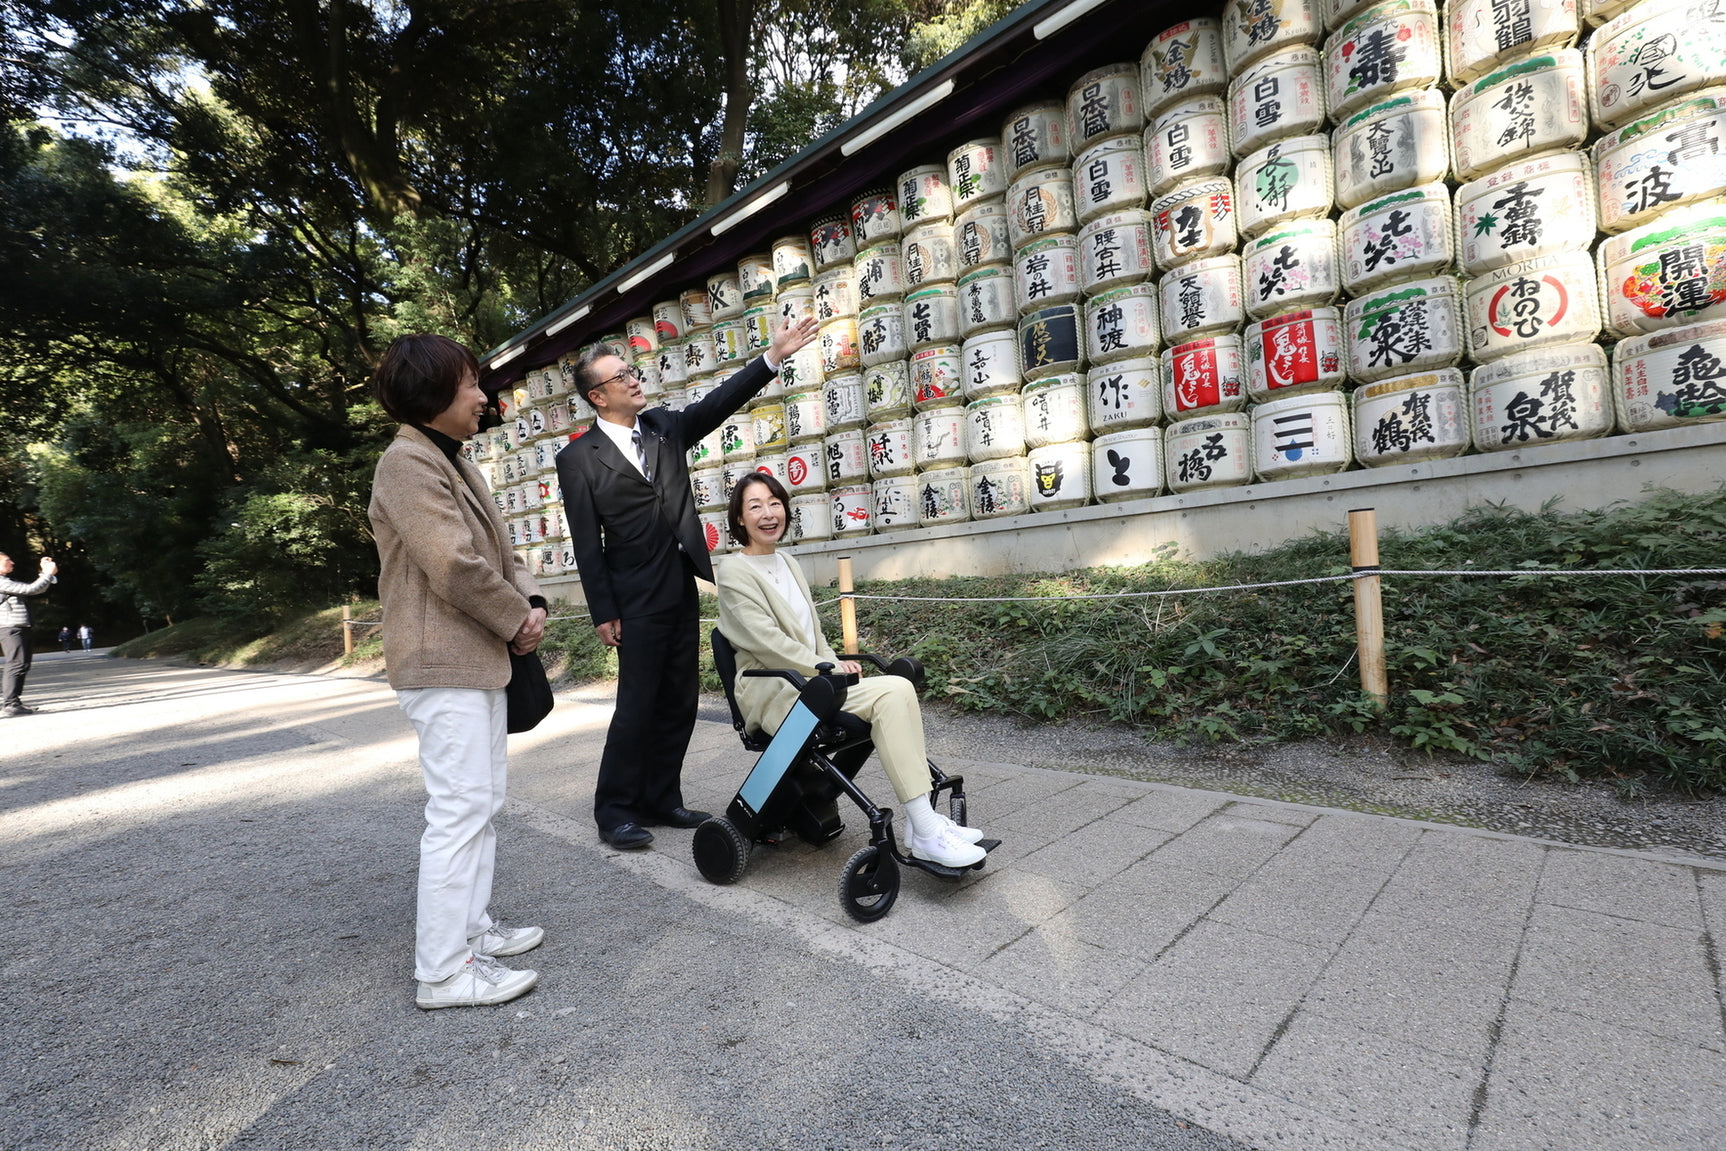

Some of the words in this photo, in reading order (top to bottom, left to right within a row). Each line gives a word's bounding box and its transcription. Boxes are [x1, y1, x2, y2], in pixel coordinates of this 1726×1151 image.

[1254, 76, 1289, 129] 白雪
[1492, 78, 1537, 149] 秩父錦
[1168, 122, 1193, 171] 白雪
[1089, 159, 1112, 203] 白雪
[1025, 185, 1046, 234] 月桂冠
[1175, 204, 1203, 248] 力士
[1492, 181, 1546, 250] 千曲錦
[963, 222, 981, 266] 月桂冠
[1364, 210, 1413, 273] 七笑
[1026, 254, 1053, 300] 岩の井
[1259, 245, 1300, 301] 七笑
[1491, 255, 1560, 282] MORITA
[1658, 244, 1719, 319] 開運
[912, 302, 932, 343] 七賢
[1510, 276, 1543, 338] ねのひ
[715, 331, 729, 362] 東光
[746, 317, 761, 350] 東光
[1100, 374, 1129, 410] 作
[1103, 411, 1128, 422] ZAKU
[1501, 369, 1579, 445] 賀茂泉
[1372, 391, 1436, 455] 賀茂鶴
[827, 442, 844, 480] 旭日
[1178, 432, 1228, 483] 五橋
